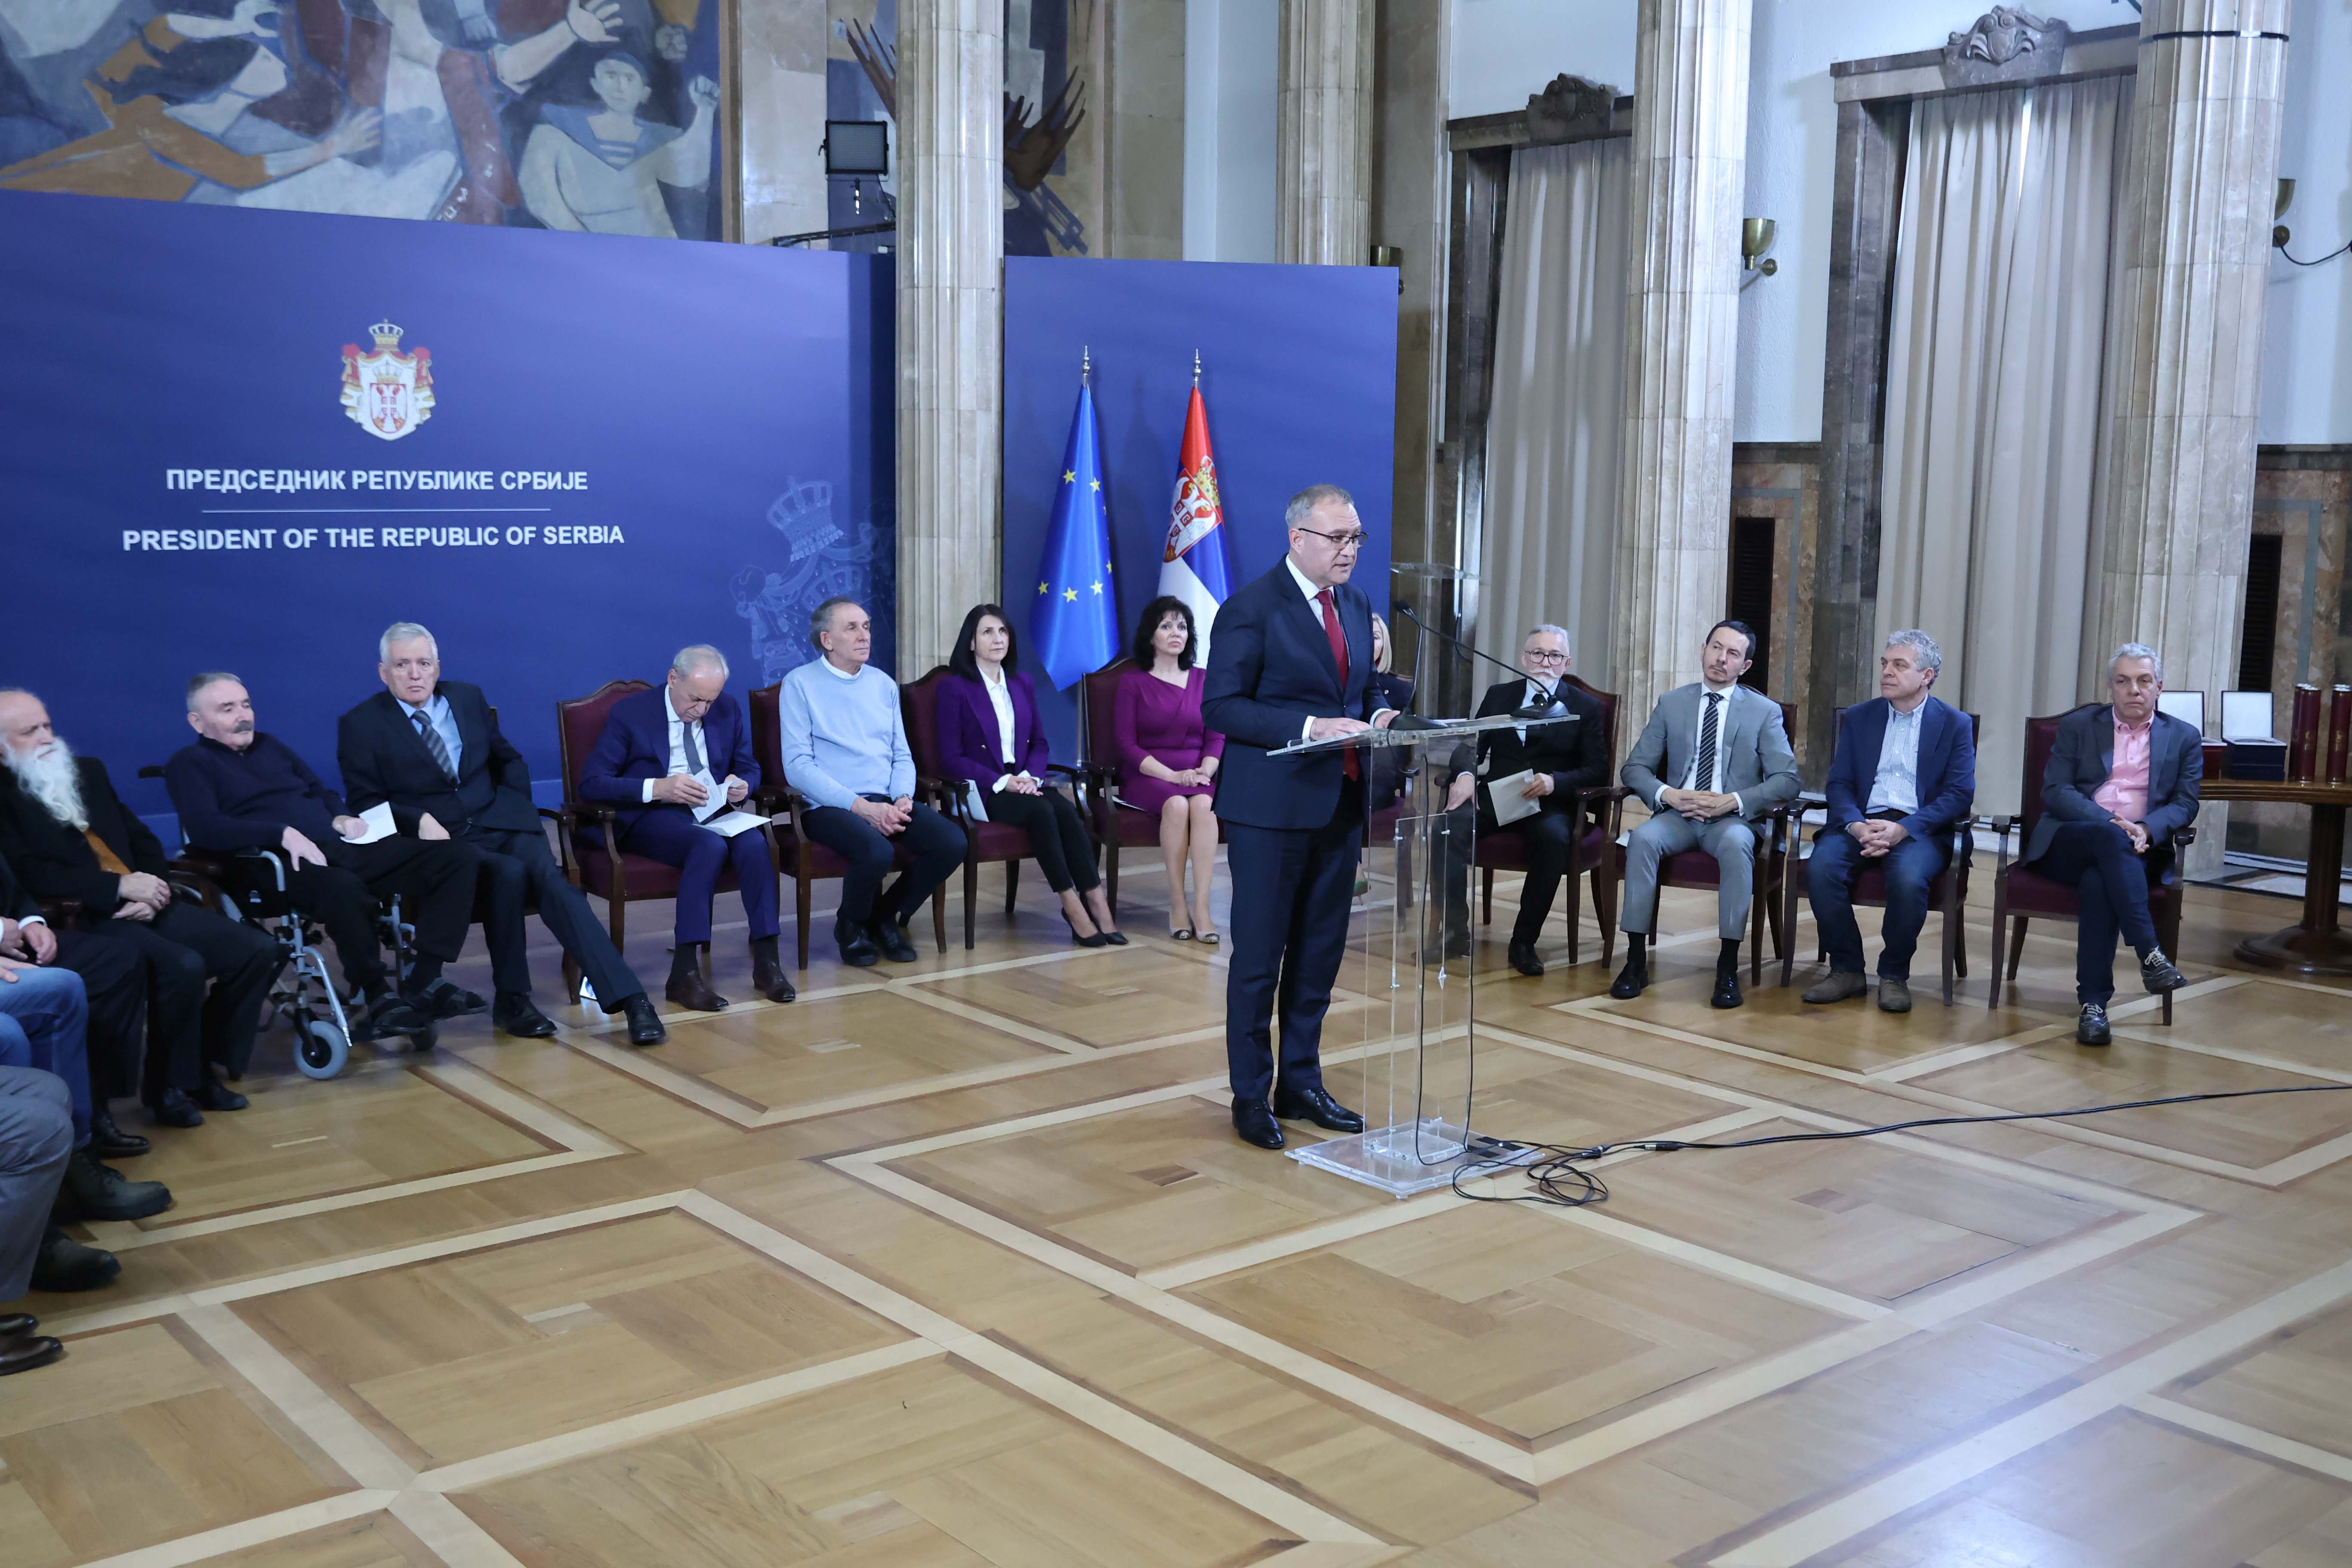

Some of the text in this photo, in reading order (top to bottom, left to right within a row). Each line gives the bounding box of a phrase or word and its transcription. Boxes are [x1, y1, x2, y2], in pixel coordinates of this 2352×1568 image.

[166, 469, 588, 493] ПРЕДСЕДНИК РЕПУБЛИКЕ СРБИЈЕ
[122, 525, 625, 551] PRESIDENT OF THE REPUBLIC OF SERBIA
